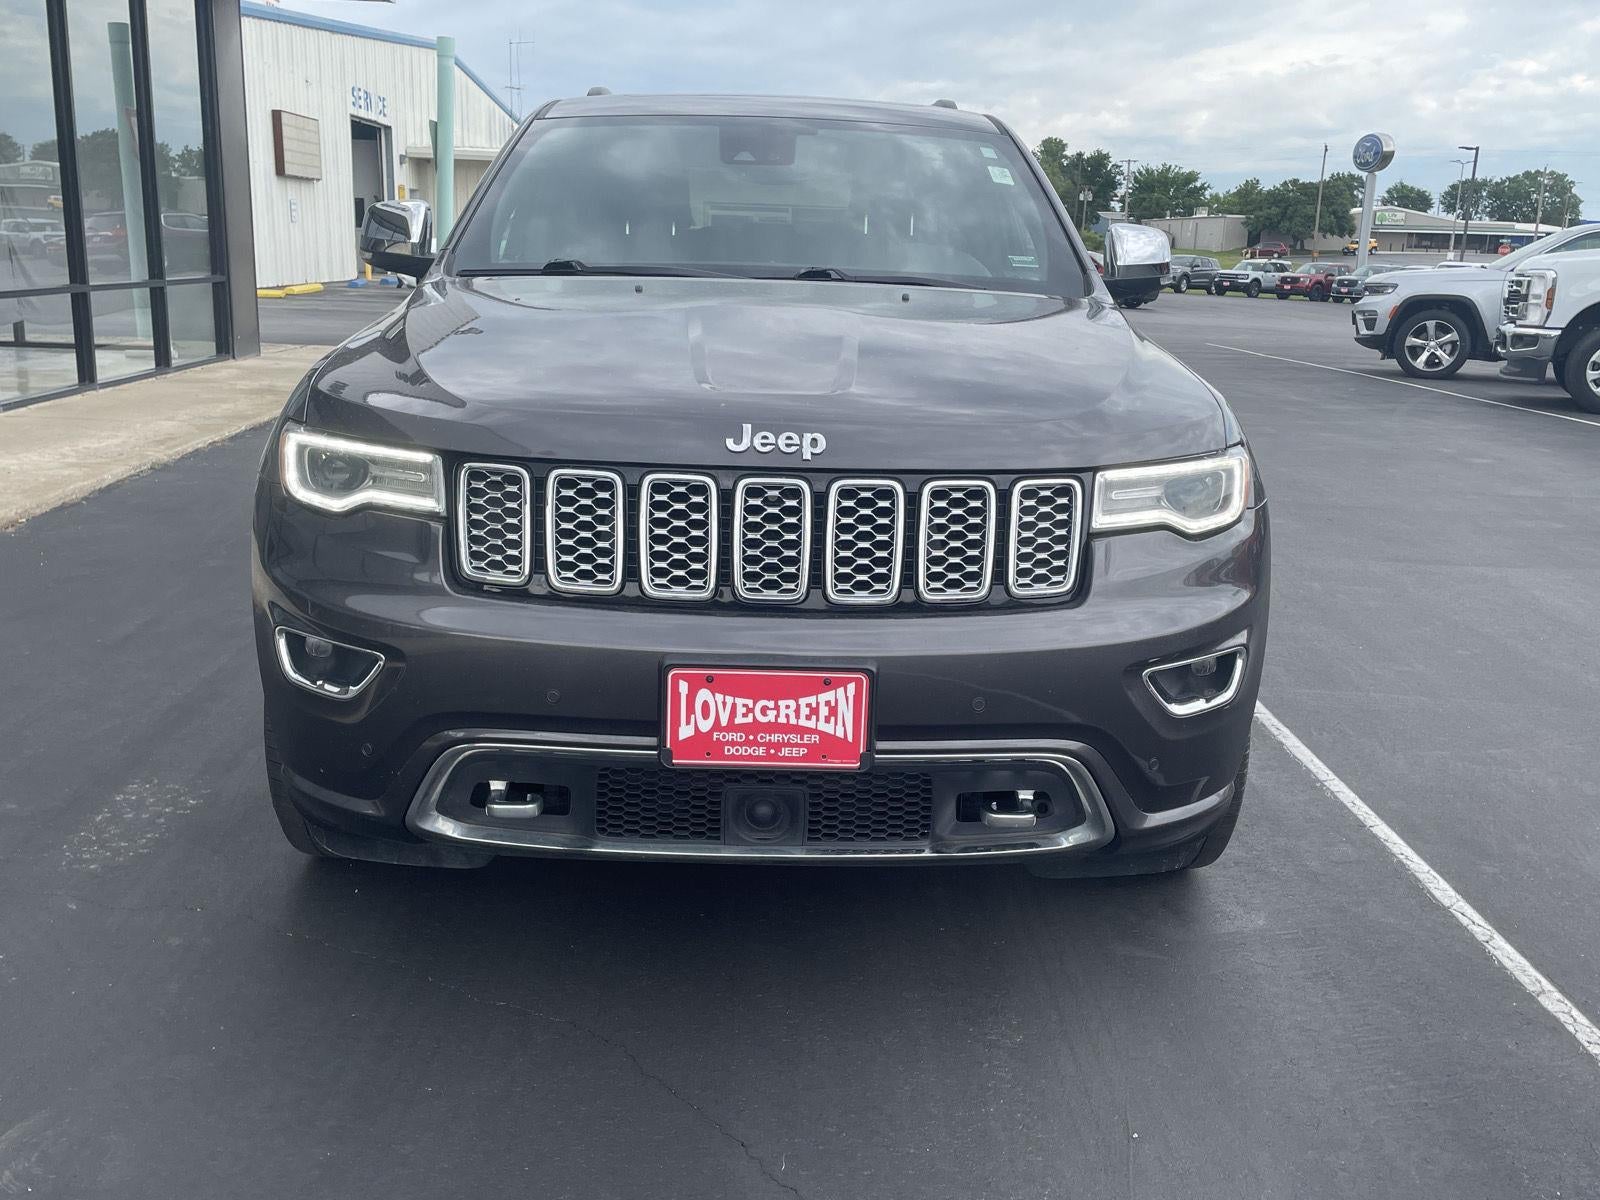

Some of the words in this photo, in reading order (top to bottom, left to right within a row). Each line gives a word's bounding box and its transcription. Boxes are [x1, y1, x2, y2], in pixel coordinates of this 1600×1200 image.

[351, 86, 388, 118] SERVCE
[725, 423, 827, 461] Jeep
[678, 679, 856, 743] LOVEGREEN
[713, 731, 746, 742] FORD
[757, 732, 820, 744] CHRYSLER
[724, 745, 767, 756] DODGE
[778, 747, 808, 757] JEEP
